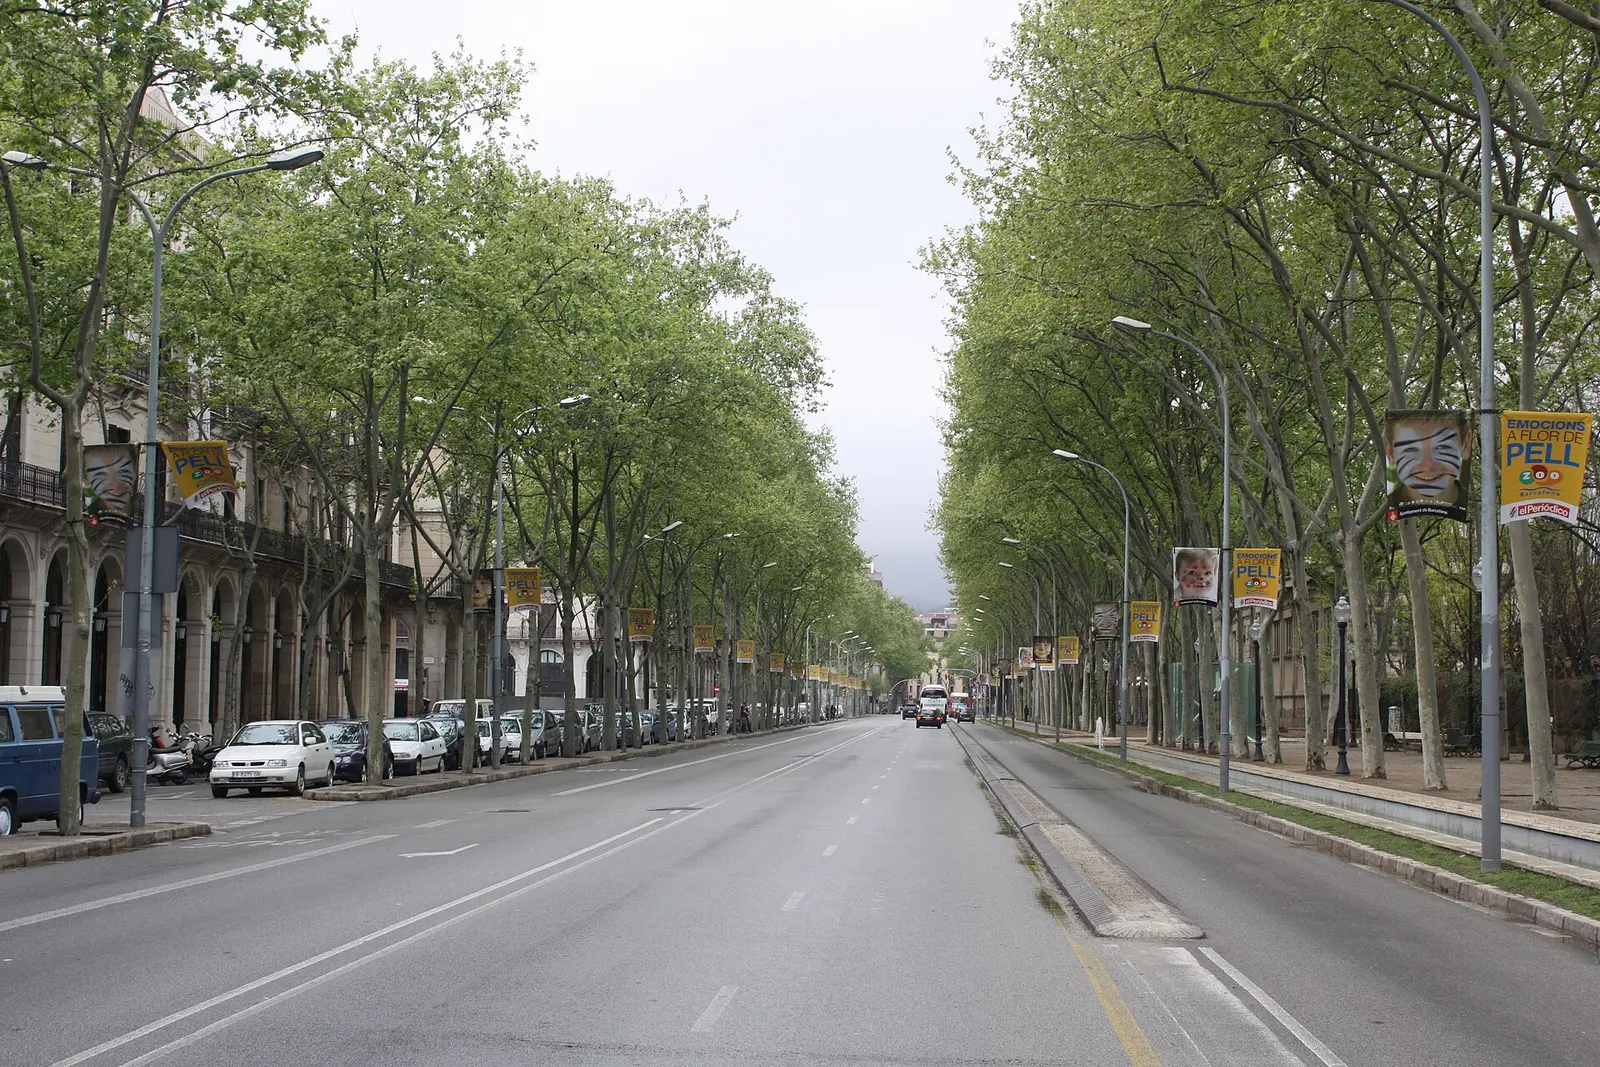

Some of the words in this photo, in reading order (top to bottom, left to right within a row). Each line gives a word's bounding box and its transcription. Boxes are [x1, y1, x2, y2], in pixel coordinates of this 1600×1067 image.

[1507, 419, 1585, 431] EMOCIONS
[1507, 430, 1516, 442] A
[1520, 430, 1560, 441] FLOR
[1563, 431, 1584, 445] DE
[1507, 442, 1580, 467] PELL
[175, 455, 229, 475] PELL
[1237, 565, 1276, 578] PELL
[509, 581, 537, 590] PELL
[1132, 613, 1157, 621] PELL
